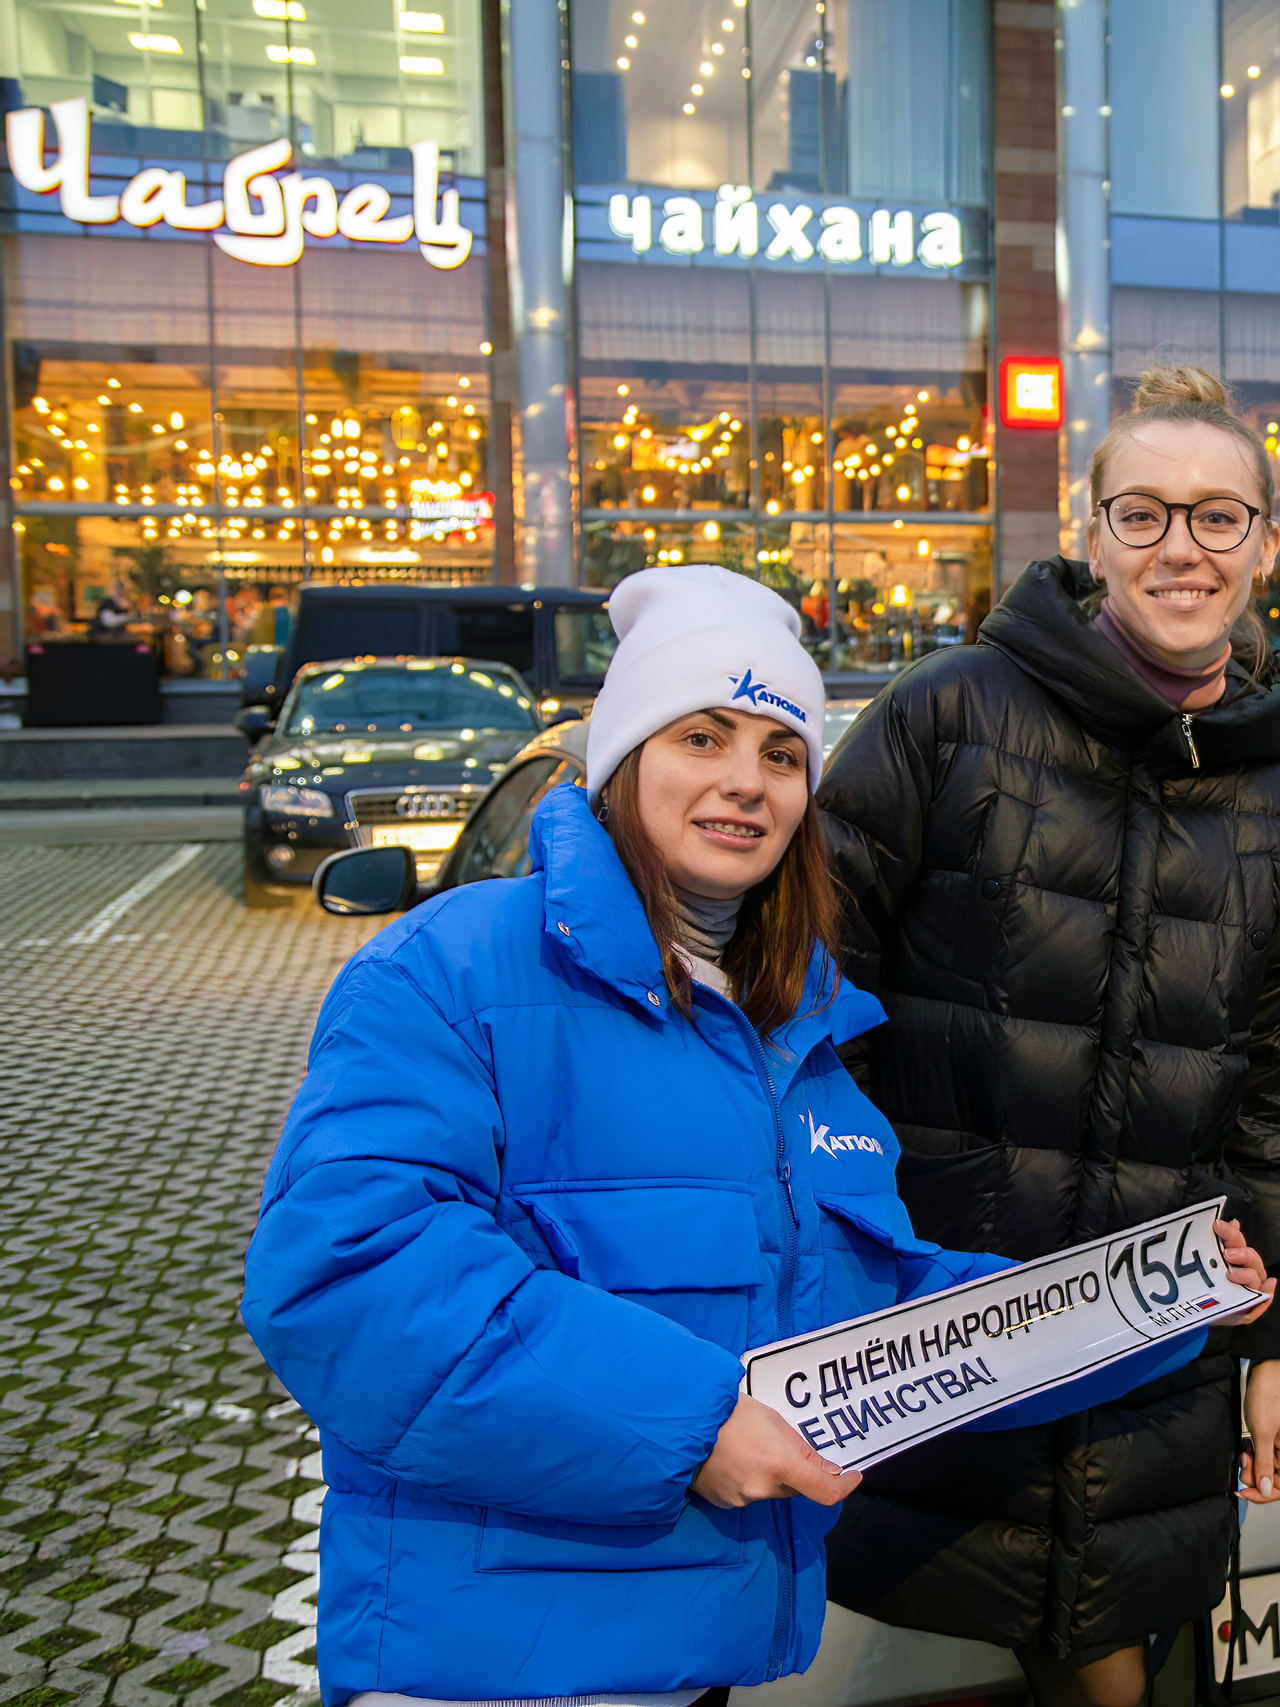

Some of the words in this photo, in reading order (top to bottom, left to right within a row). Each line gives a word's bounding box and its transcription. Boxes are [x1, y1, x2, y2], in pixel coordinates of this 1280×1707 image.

[6, 98, 473, 270] Чабрец
[609, 185, 963, 268] чайхана
[785, 1372, 811, 1408] С
[818, 1340, 916, 1407] ДНЁМ
[920, 1270, 1101, 1363] НАРОДНОГО
[797, 1355, 999, 1451] ЕДИНСТВА!
